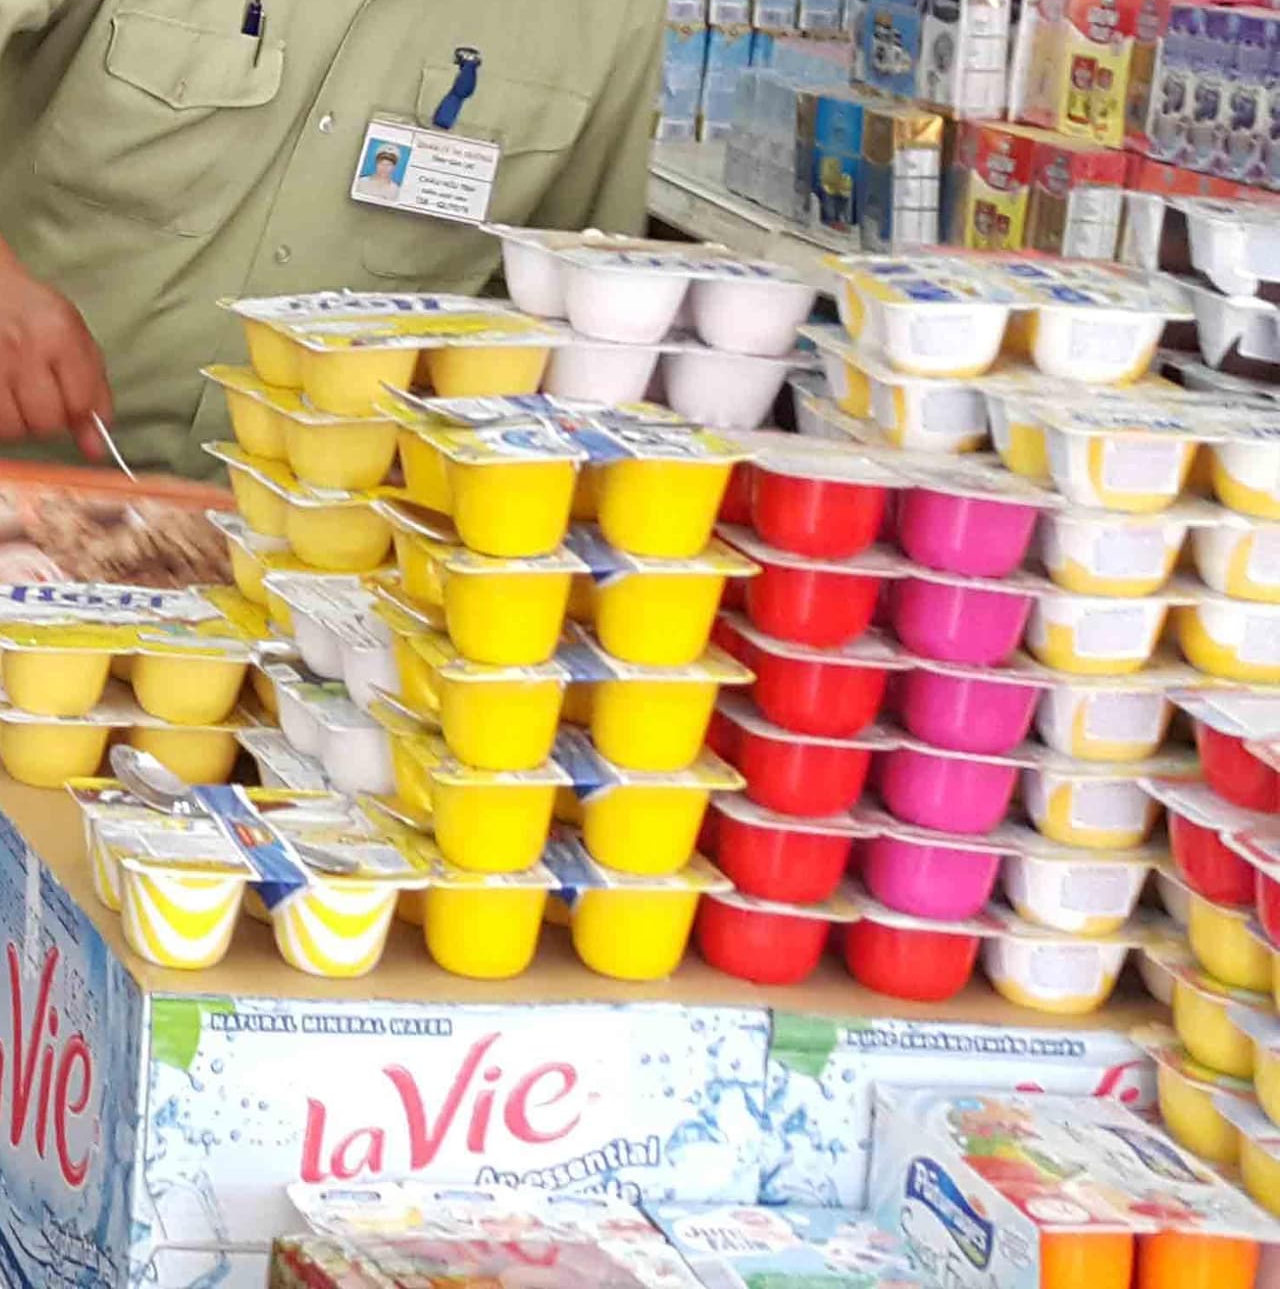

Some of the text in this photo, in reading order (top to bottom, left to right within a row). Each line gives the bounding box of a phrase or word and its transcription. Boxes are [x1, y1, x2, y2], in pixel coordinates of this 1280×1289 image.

[210, 1013, 453, 1036] NATURAL MINERAL WATER
